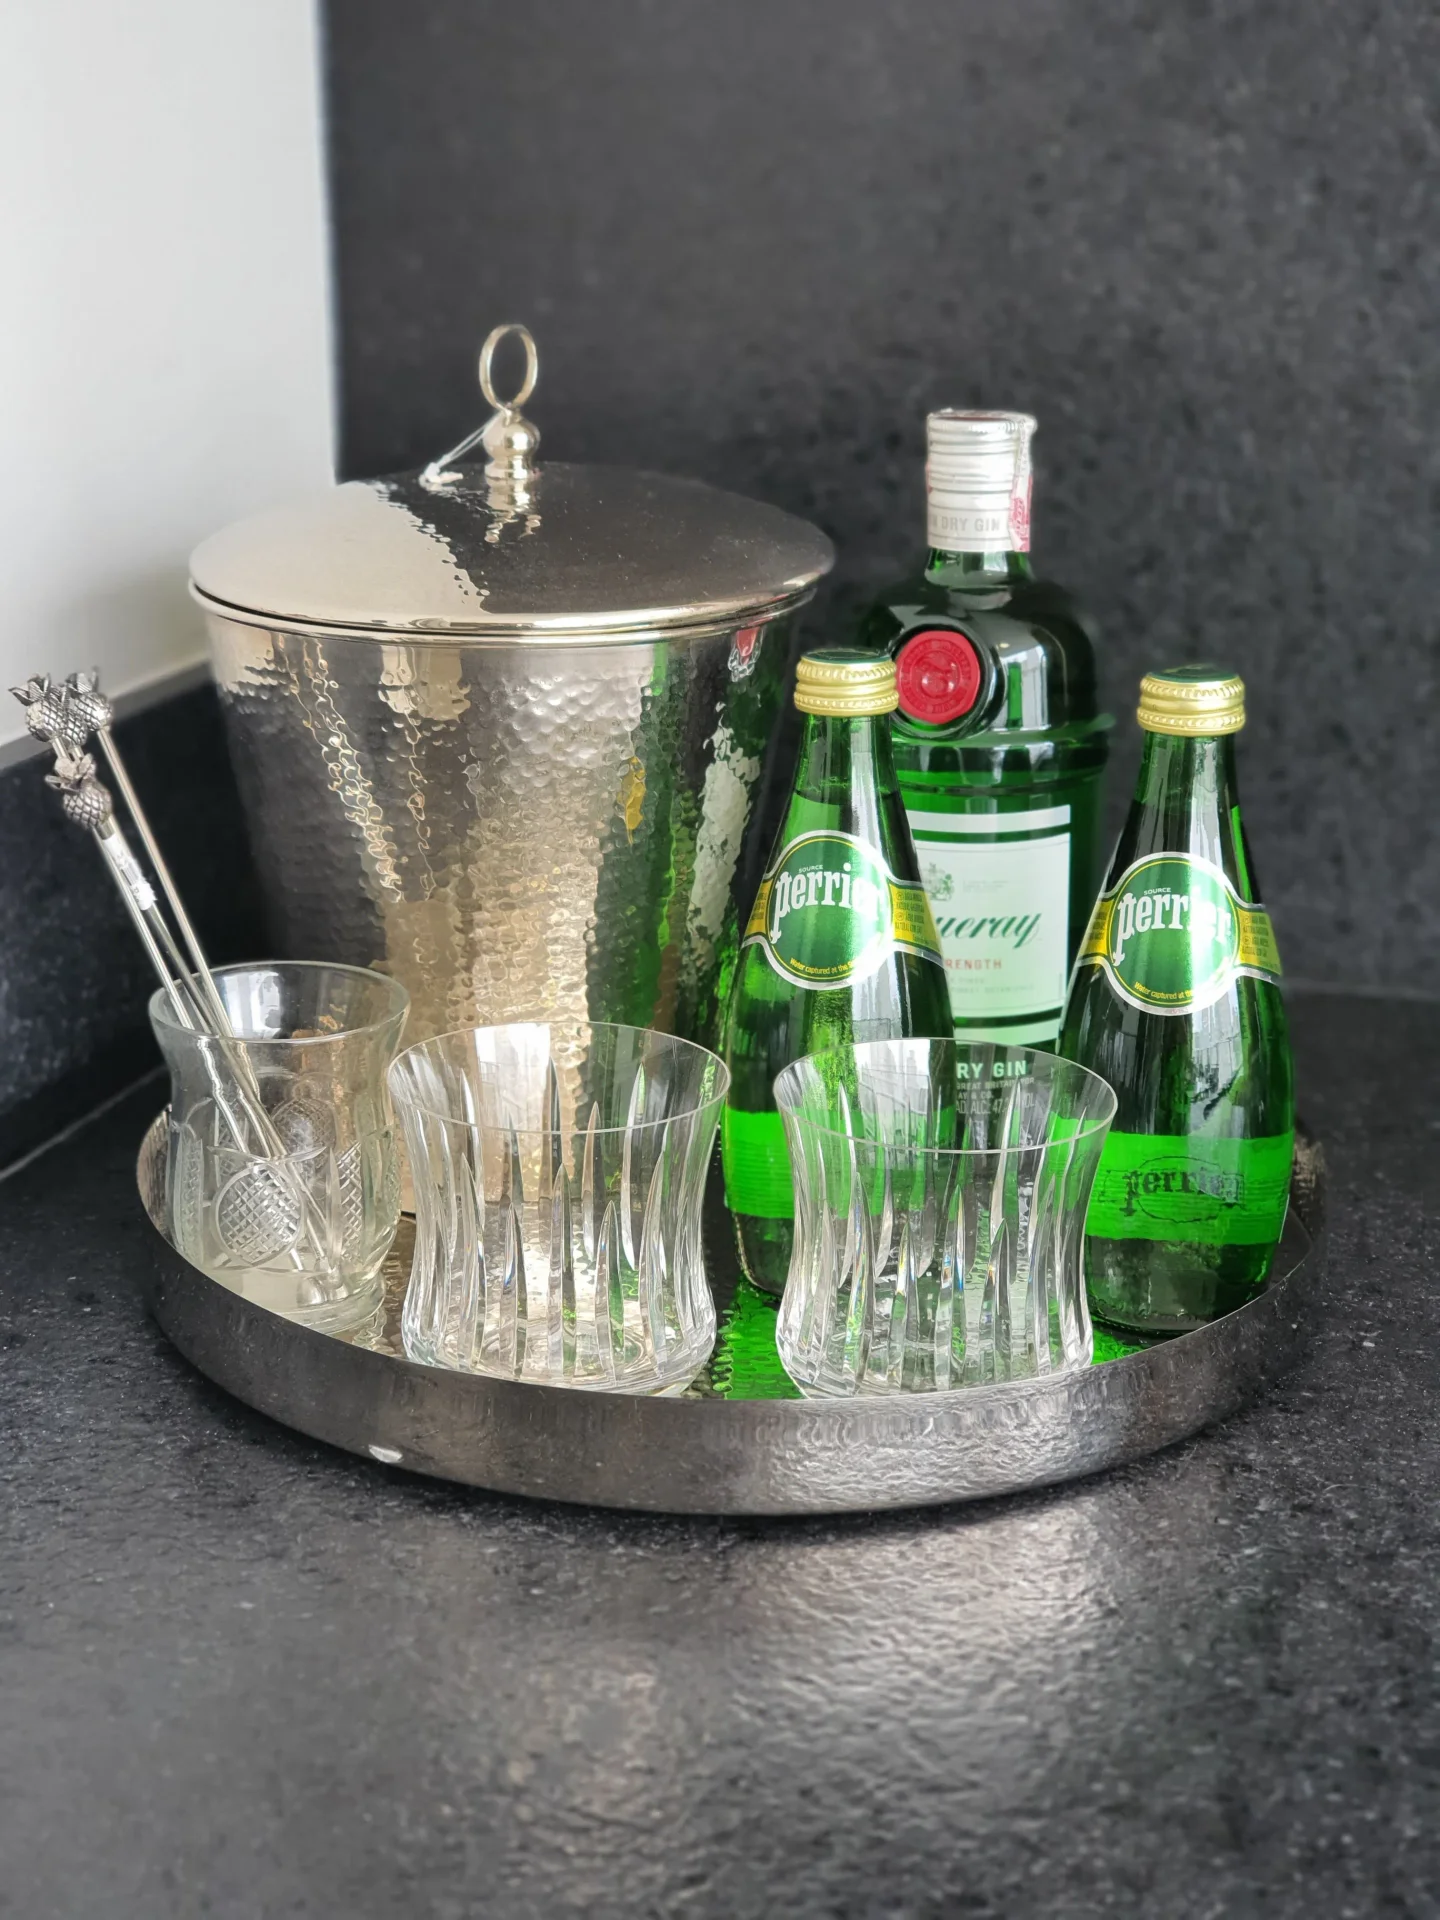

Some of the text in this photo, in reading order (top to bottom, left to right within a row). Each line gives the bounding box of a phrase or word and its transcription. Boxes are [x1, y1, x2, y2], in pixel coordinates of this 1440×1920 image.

[941, 515, 968, 531] DRY
[974, 517, 1000, 532] GIN
[798, 864, 823, 873] SOURCE
[1143, 887, 1171, 896] SOURCE
[770, 862, 885, 944] perri
[935, 912, 1041, 949] ueray
[945, 958, 1002, 970] RENGTH
[956, 1060, 1027, 1079] RY GIN
